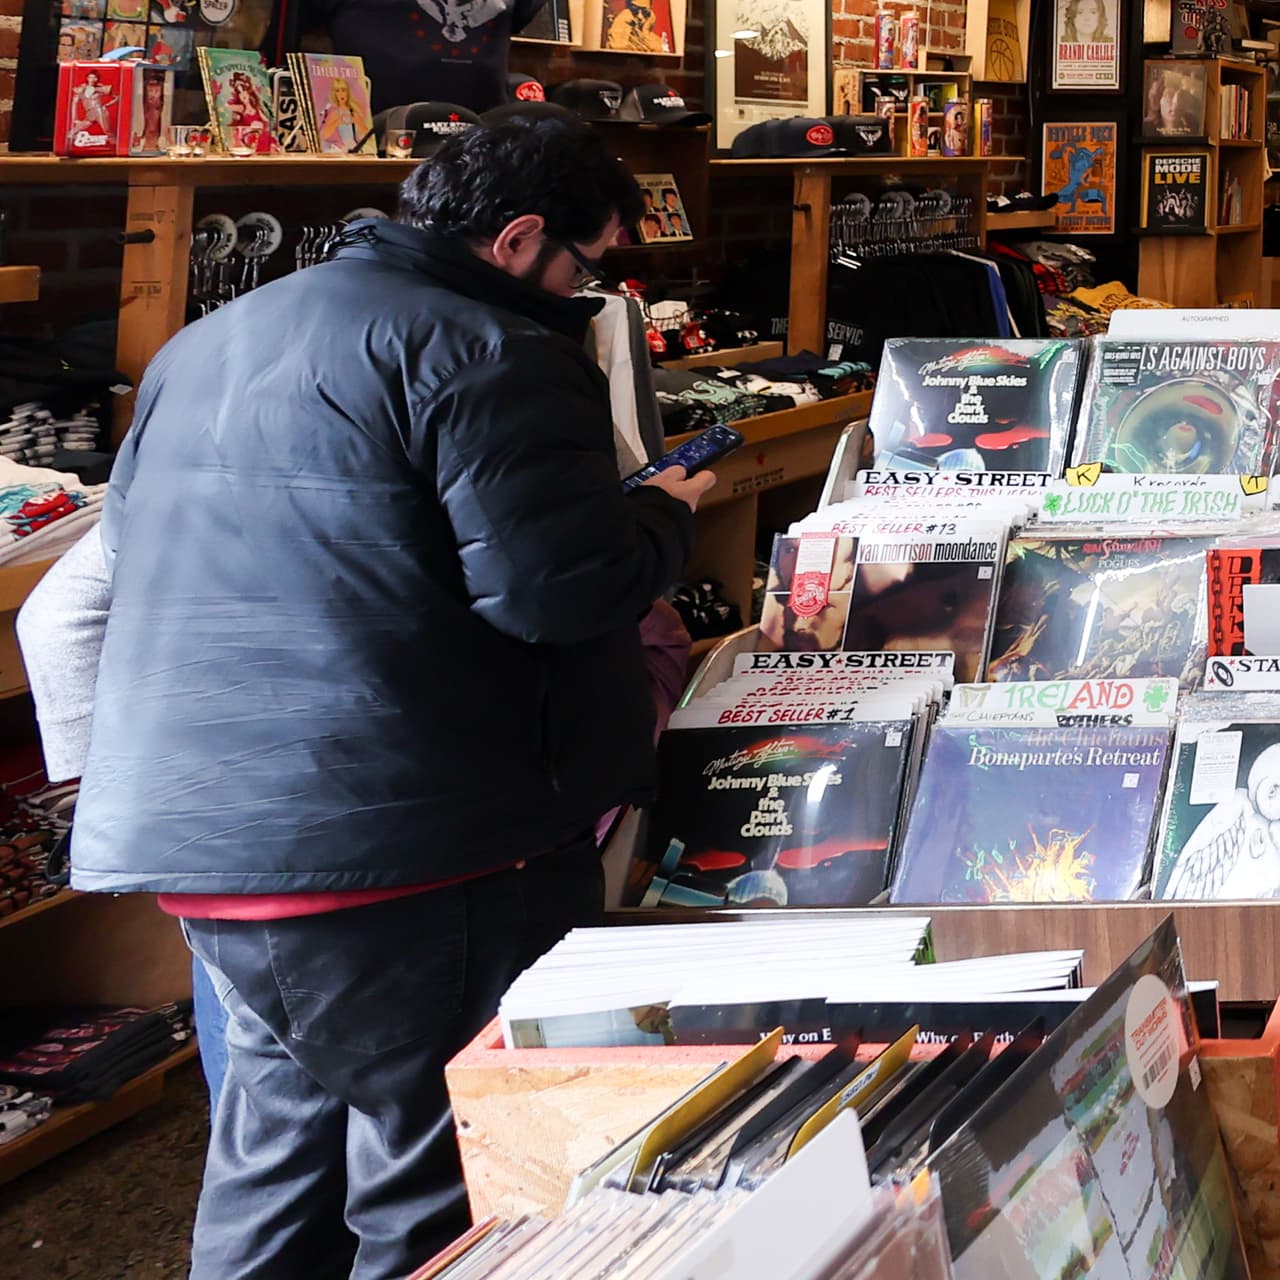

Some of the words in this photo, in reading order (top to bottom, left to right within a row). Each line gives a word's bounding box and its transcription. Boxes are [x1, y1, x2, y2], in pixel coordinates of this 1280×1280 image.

[1059, 44, 1085, 61] BRANDI
[1087, 44, 1114, 61] CARLILE
[1155, 164, 1201, 173] MODE
[1155, 174, 1201, 184] LIVE
[1160, 347, 1224, 371] AGAINST
[1227, 347, 1267, 371] BOYS
[922, 374, 964, 390] Johnny
[966, 374, 993, 387] Blue
[995, 374, 1028, 387] Skies
[961, 394, 983, 404] the
[863, 471, 941, 487] EASY
[954, 473, 1052, 488] STREET
[859, 543, 879, 562] van
[883, 538, 932, 562] morrison
[933, 537, 997, 560] moondance
[1098, 558, 1140, 568] POGUES
[750, 653, 835, 669] EASY
[844, 653, 953, 668] STREET
[1006, 681, 1134, 712] IRELAND
[718, 708, 763, 725] BEST
[766, 708, 826, 723] SELLER
[827, 707, 855, 722] #1
[969, 748, 1082, 770] Bonaparte's
[1087, 748, 1160, 766] Retreat
[707, 773, 765, 792] Johnny
[766, 773, 801, 790] Blue
[758, 797, 785, 812] the
[749, 809, 788, 825] Dark
